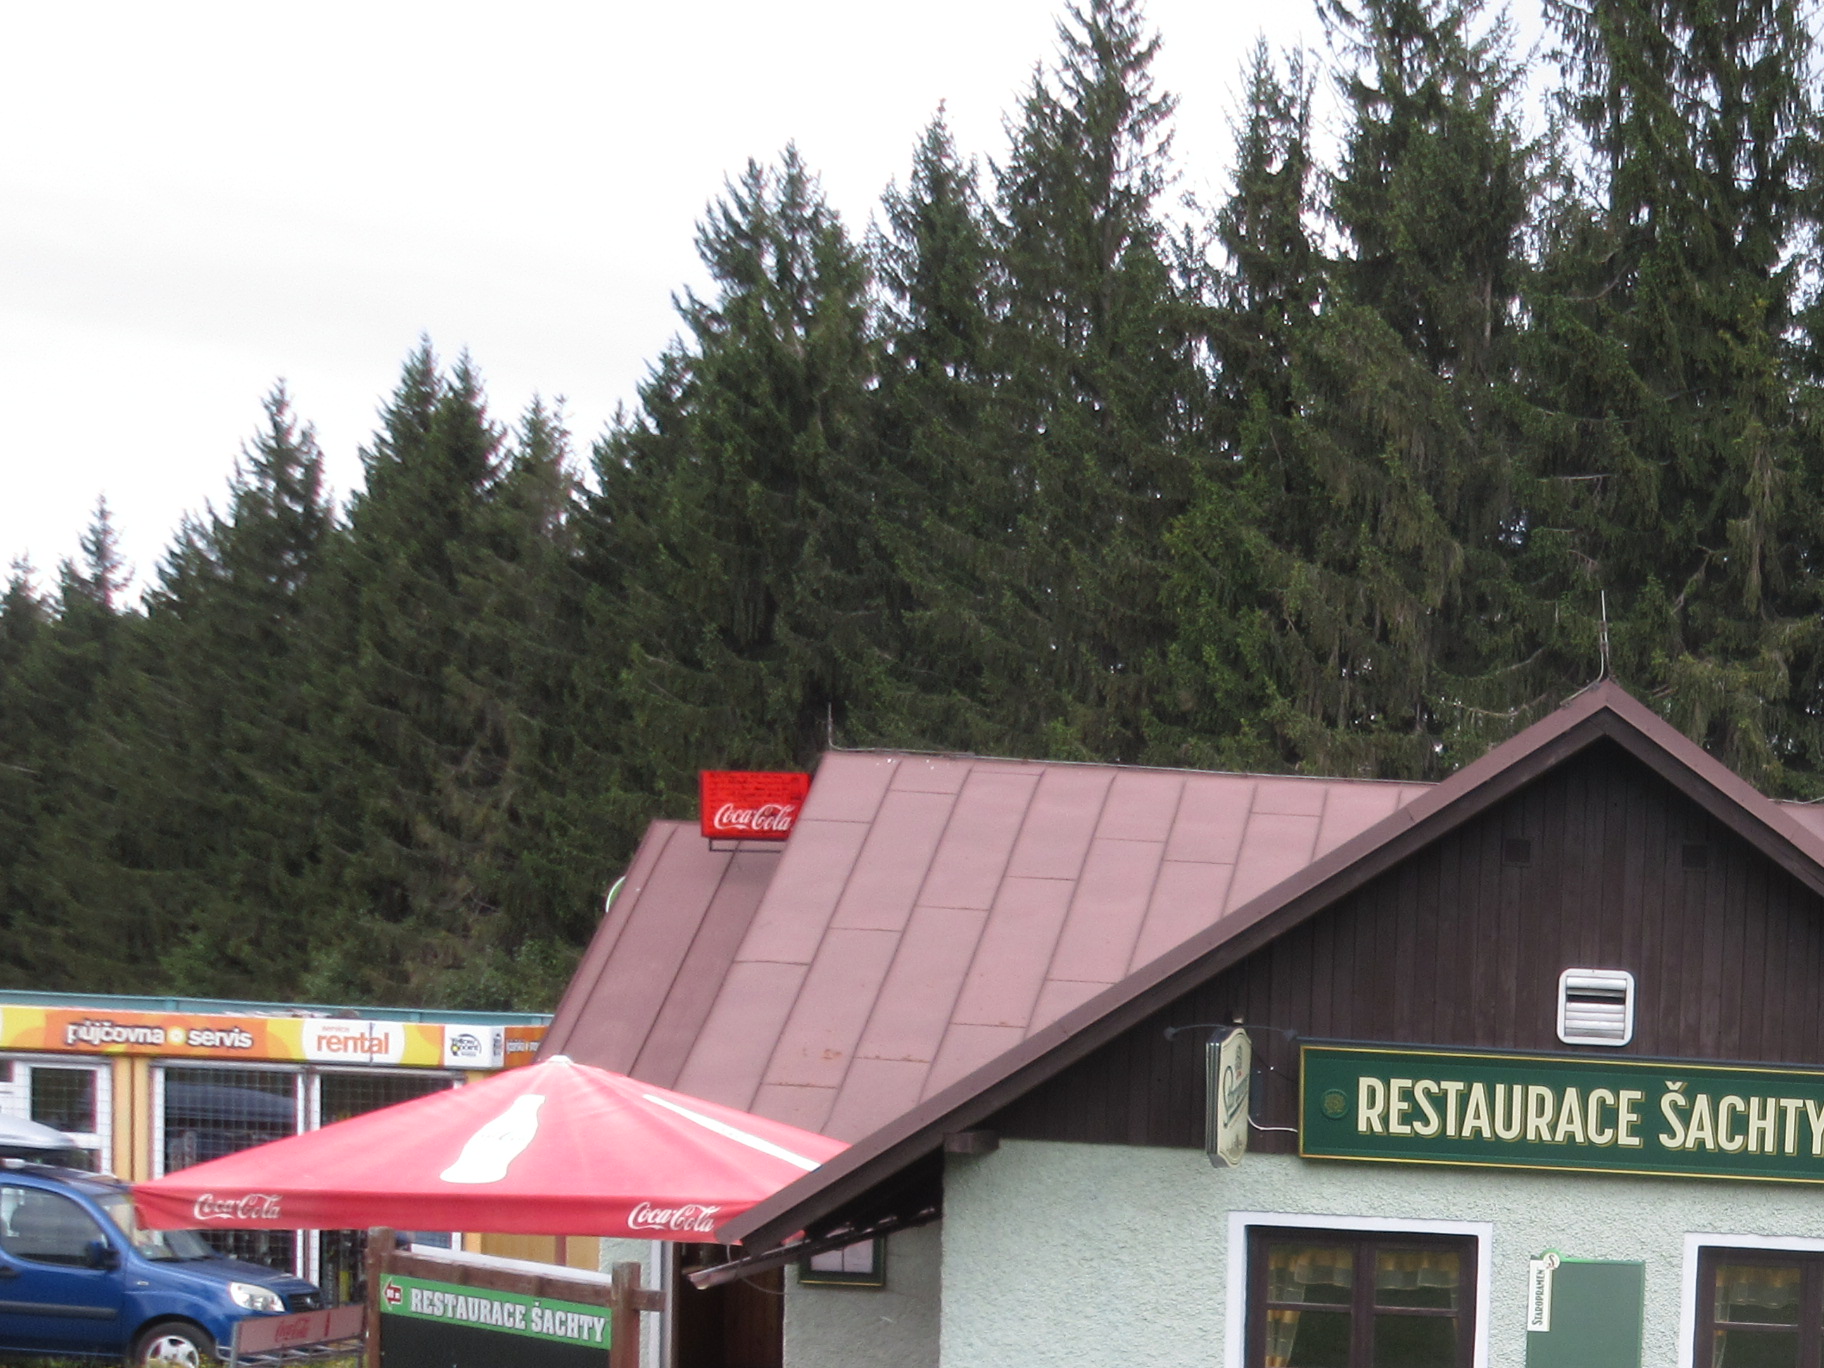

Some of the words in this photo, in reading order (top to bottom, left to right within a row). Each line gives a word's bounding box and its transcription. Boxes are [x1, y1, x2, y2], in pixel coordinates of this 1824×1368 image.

[714, 803, 795, 830] Coca-Cola
[187, 1028, 252, 1048] servis
[317, 1032, 389, 1054] rental
[1357, 1077, 1644, 1147] RESTAURACE
[194, 1193, 283, 1220] Coca-Cola
[627, 1201, 720, 1232] Coca-Cola
[411, 1287, 526, 1330] RESTAURACE
[531, 1301, 605, 1342] ŠACHTY
